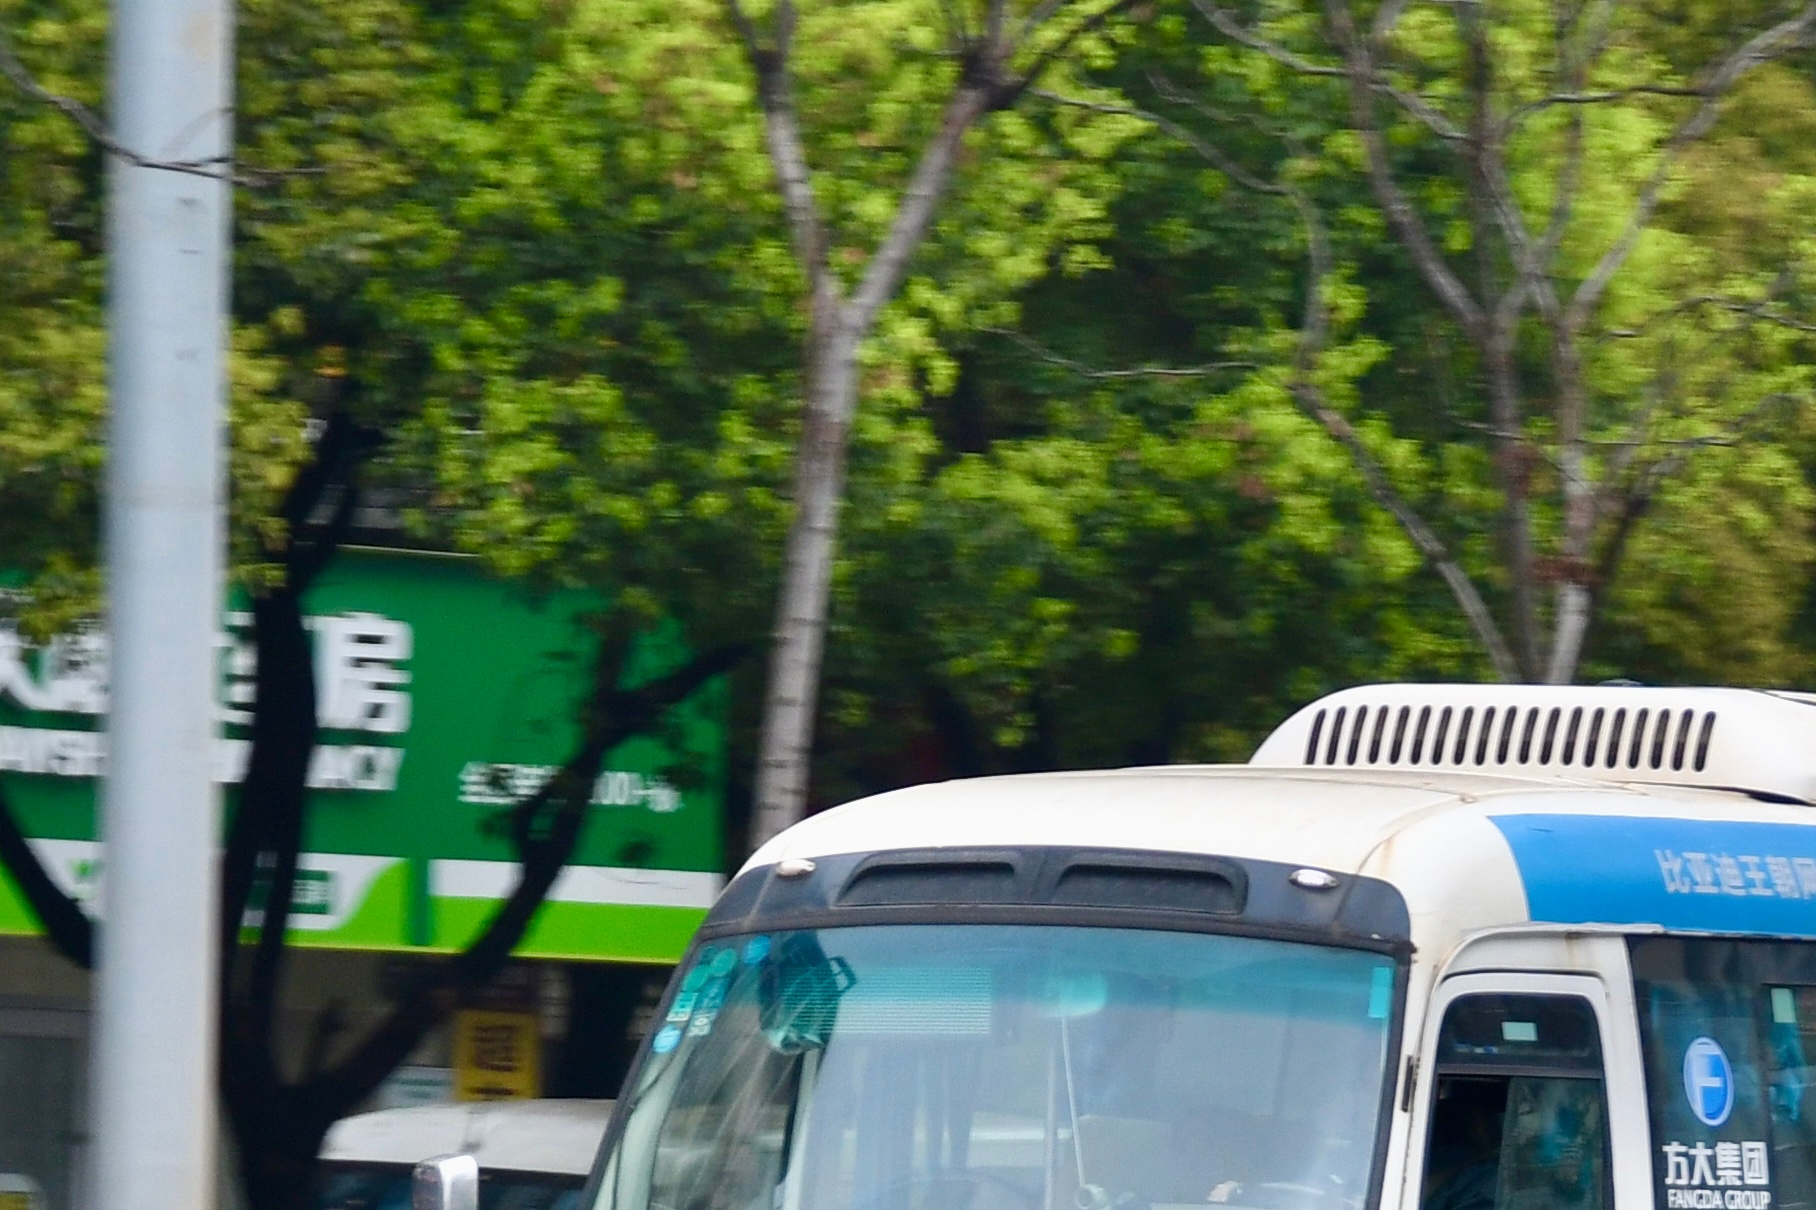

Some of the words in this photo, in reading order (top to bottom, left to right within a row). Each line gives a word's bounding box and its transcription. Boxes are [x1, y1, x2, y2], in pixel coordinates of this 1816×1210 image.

[1661, 1141, 1770, 1186] 方大集团
[1666, 1188, 1724, 1210] FANGDA
[1724, 1190, 1772, 1210] GROUP
